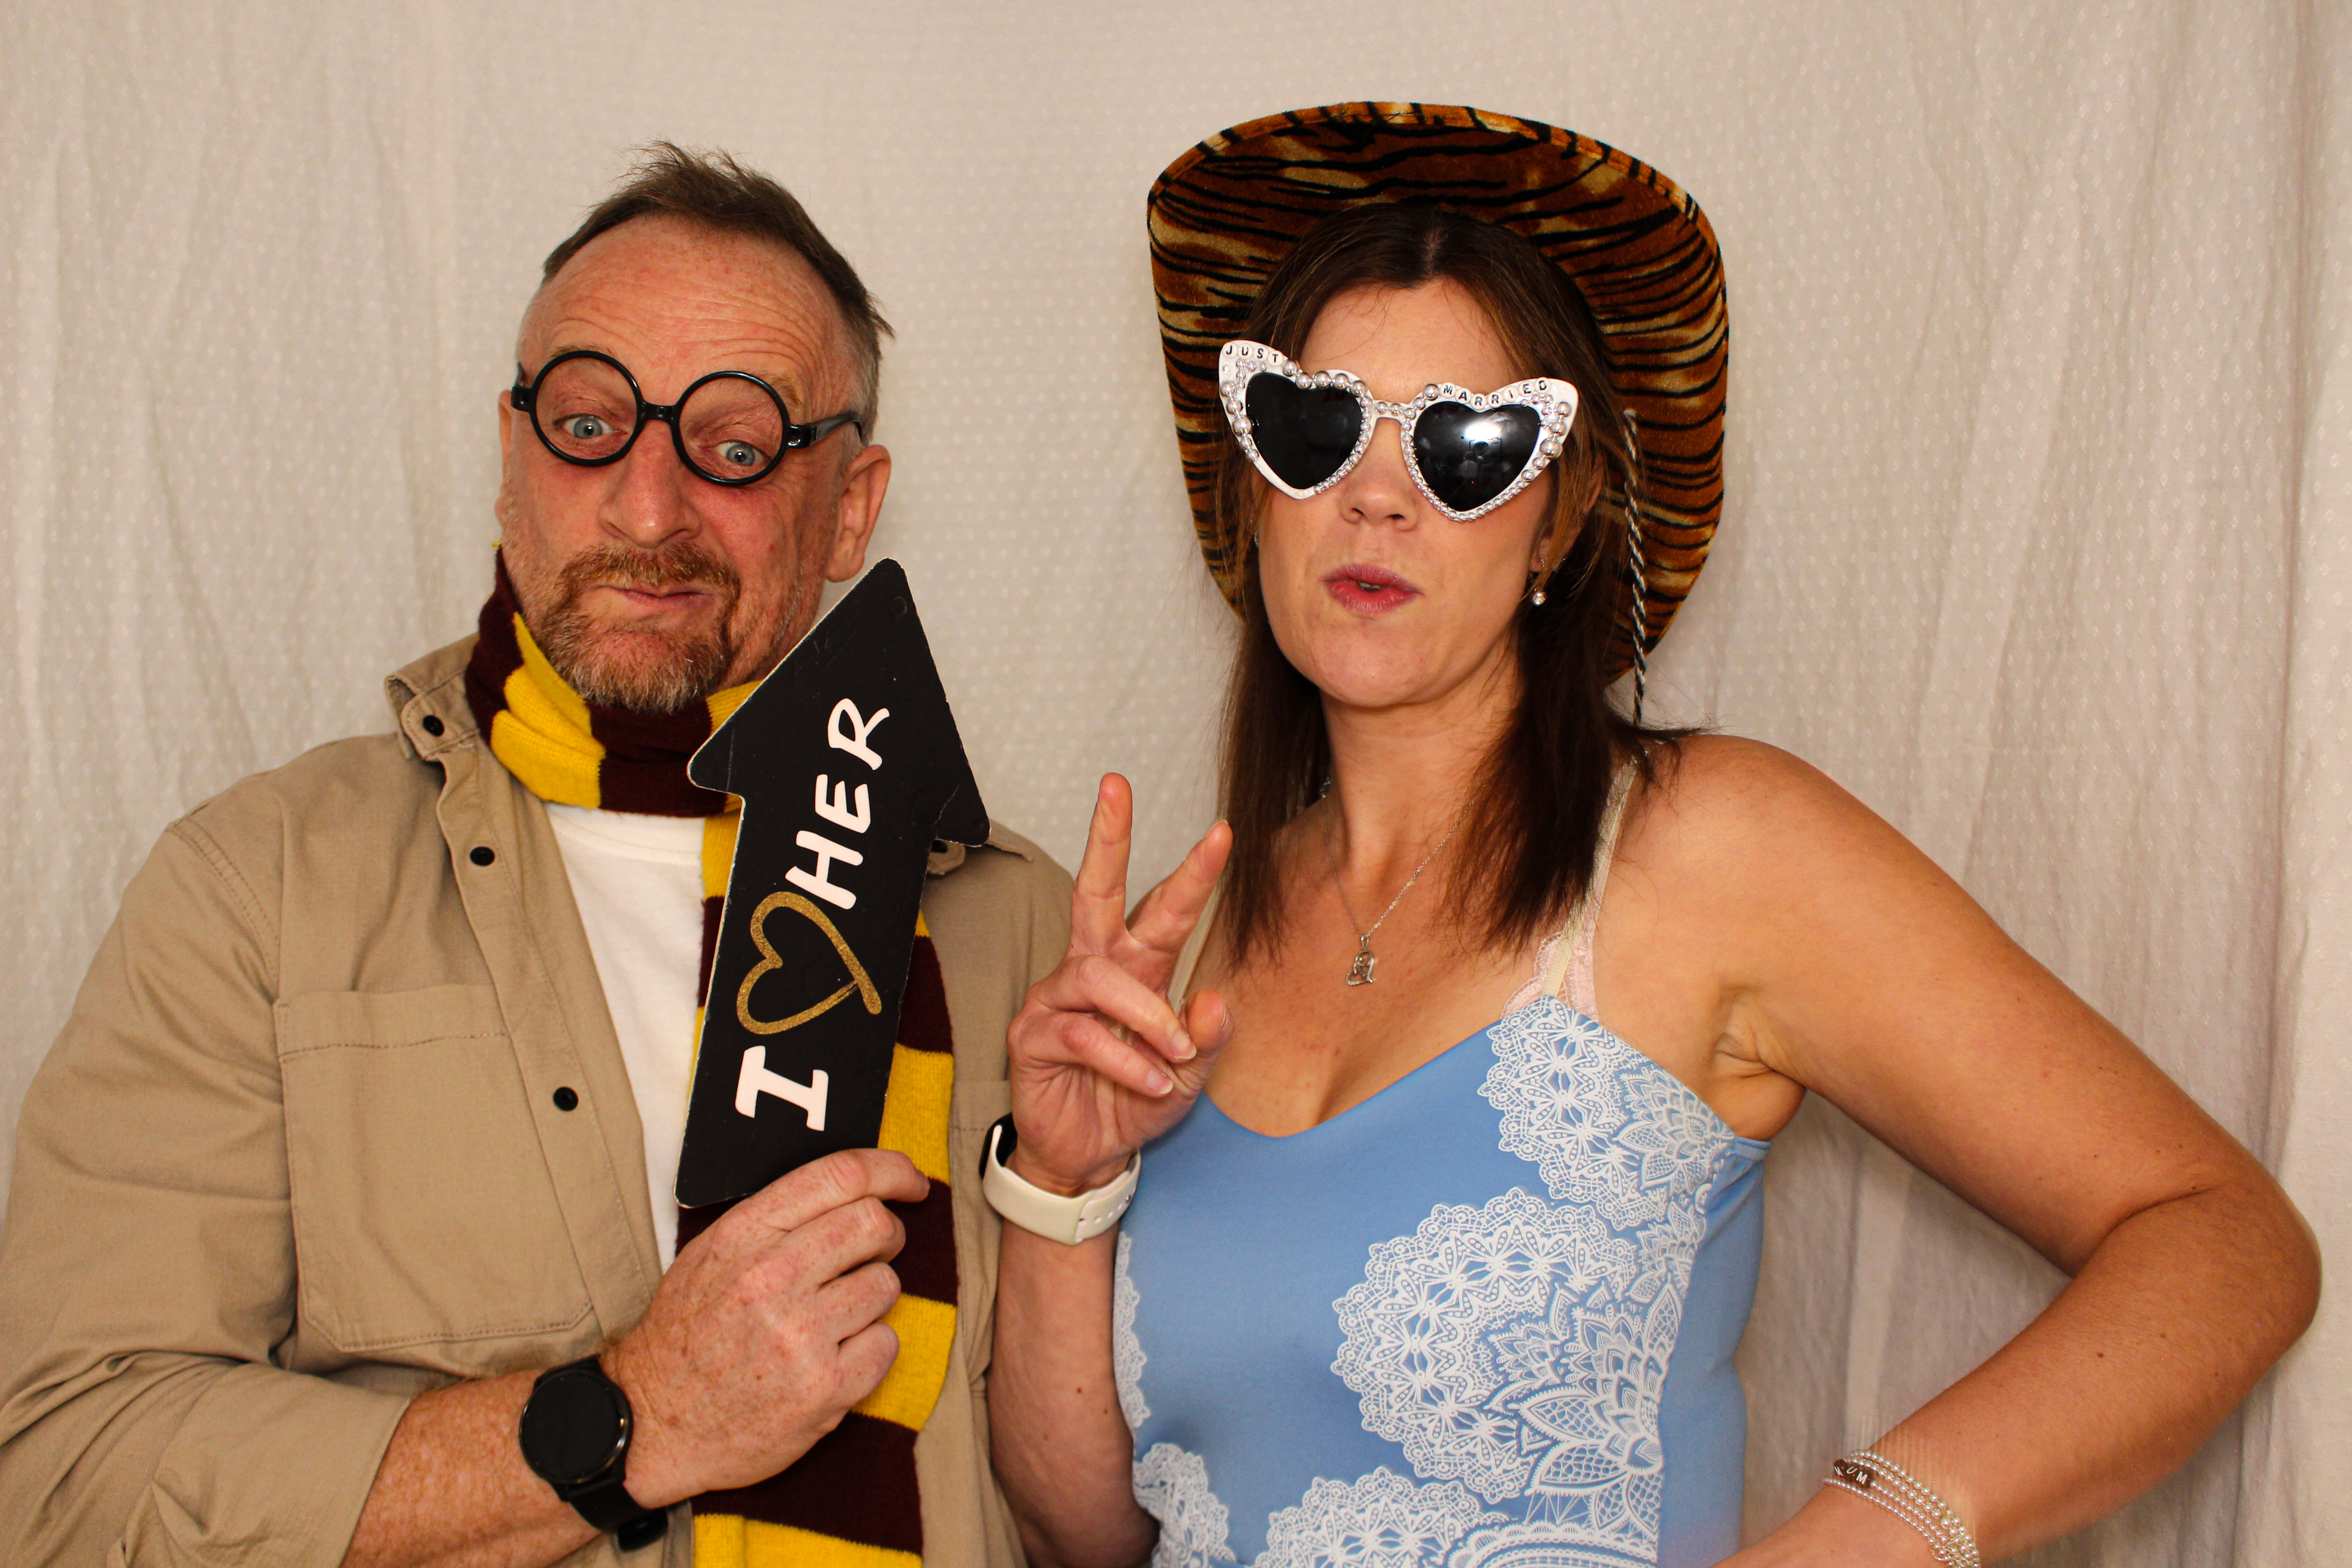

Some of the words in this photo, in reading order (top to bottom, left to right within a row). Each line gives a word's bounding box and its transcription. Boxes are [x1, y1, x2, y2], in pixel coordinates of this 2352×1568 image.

[1225, 344, 1279, 363] JUST
[1443, 379, 1548, 407] MARRIED
[735, 1045, 829, 1132] I
[785, 698, 890, 910] HER
